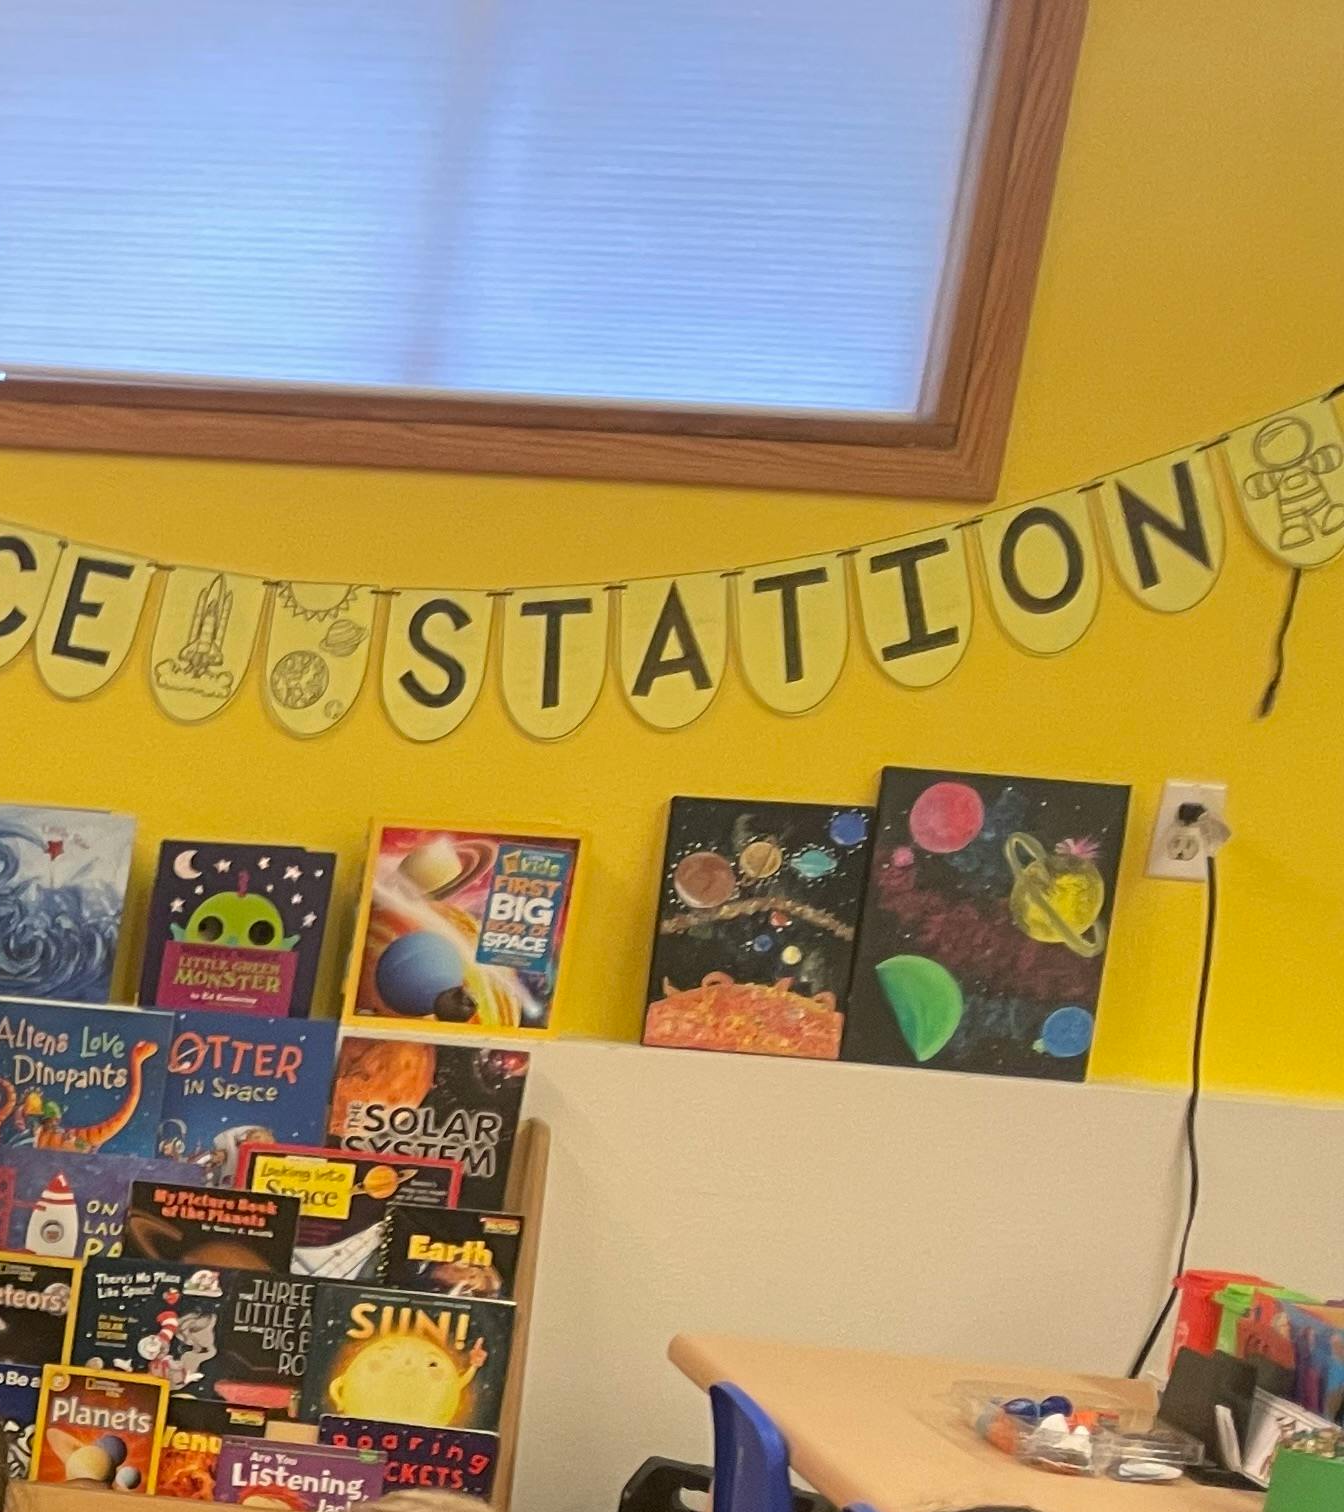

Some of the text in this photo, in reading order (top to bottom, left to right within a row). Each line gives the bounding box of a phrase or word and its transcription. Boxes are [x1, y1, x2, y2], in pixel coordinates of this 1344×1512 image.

[397, 461, 1214, 708] STATION
[494, 875, 562, 898] FIRST
[489, 893, 554, 926] BIG
[481, 931, 548, 953] SPACE
[179, 955, 227, 970] LITTLE
[172, 968, 282, 993] MONSTER
[80, 1026, 125, 1059] Love
[167, 1031, 303, 1084] OTTER
[13, 1053, 129, 1095] Dinopants
[212, 1077, 279, 1102] Space
[347, 1100, 363, 1130] THE
[362, 1103, 502, 1145] SOLAR
[260, 1163, 347, 1183] Looking into
[86, 1199, 119, 1217] ON
[153, 1188, 278, 1215] My Picture Book
[161, 1204, 266, 1228] of the Planets
[83, 1237, 125, 1267] PA
[407, 1233, 494, 1267] Earth
[253, 1279, 315, 1307] THREE
[234, 1301, 297, 1328] LITTLE
[346, 1302, 471, 1350] SUN!
[262, 1327, 295, 1352] BIG
[4, 1370, 29, 1387] Be
[30, 1376, 41, 1388] a
[52, 1396, 152, 1434] Planets
[162, 1425, 223, 1455] Venu
[250, 1451, 298, 1467] Are You
[231, 1463, 370, 1503] Listening,
[383, 1461, 464, 1490] CKETS
